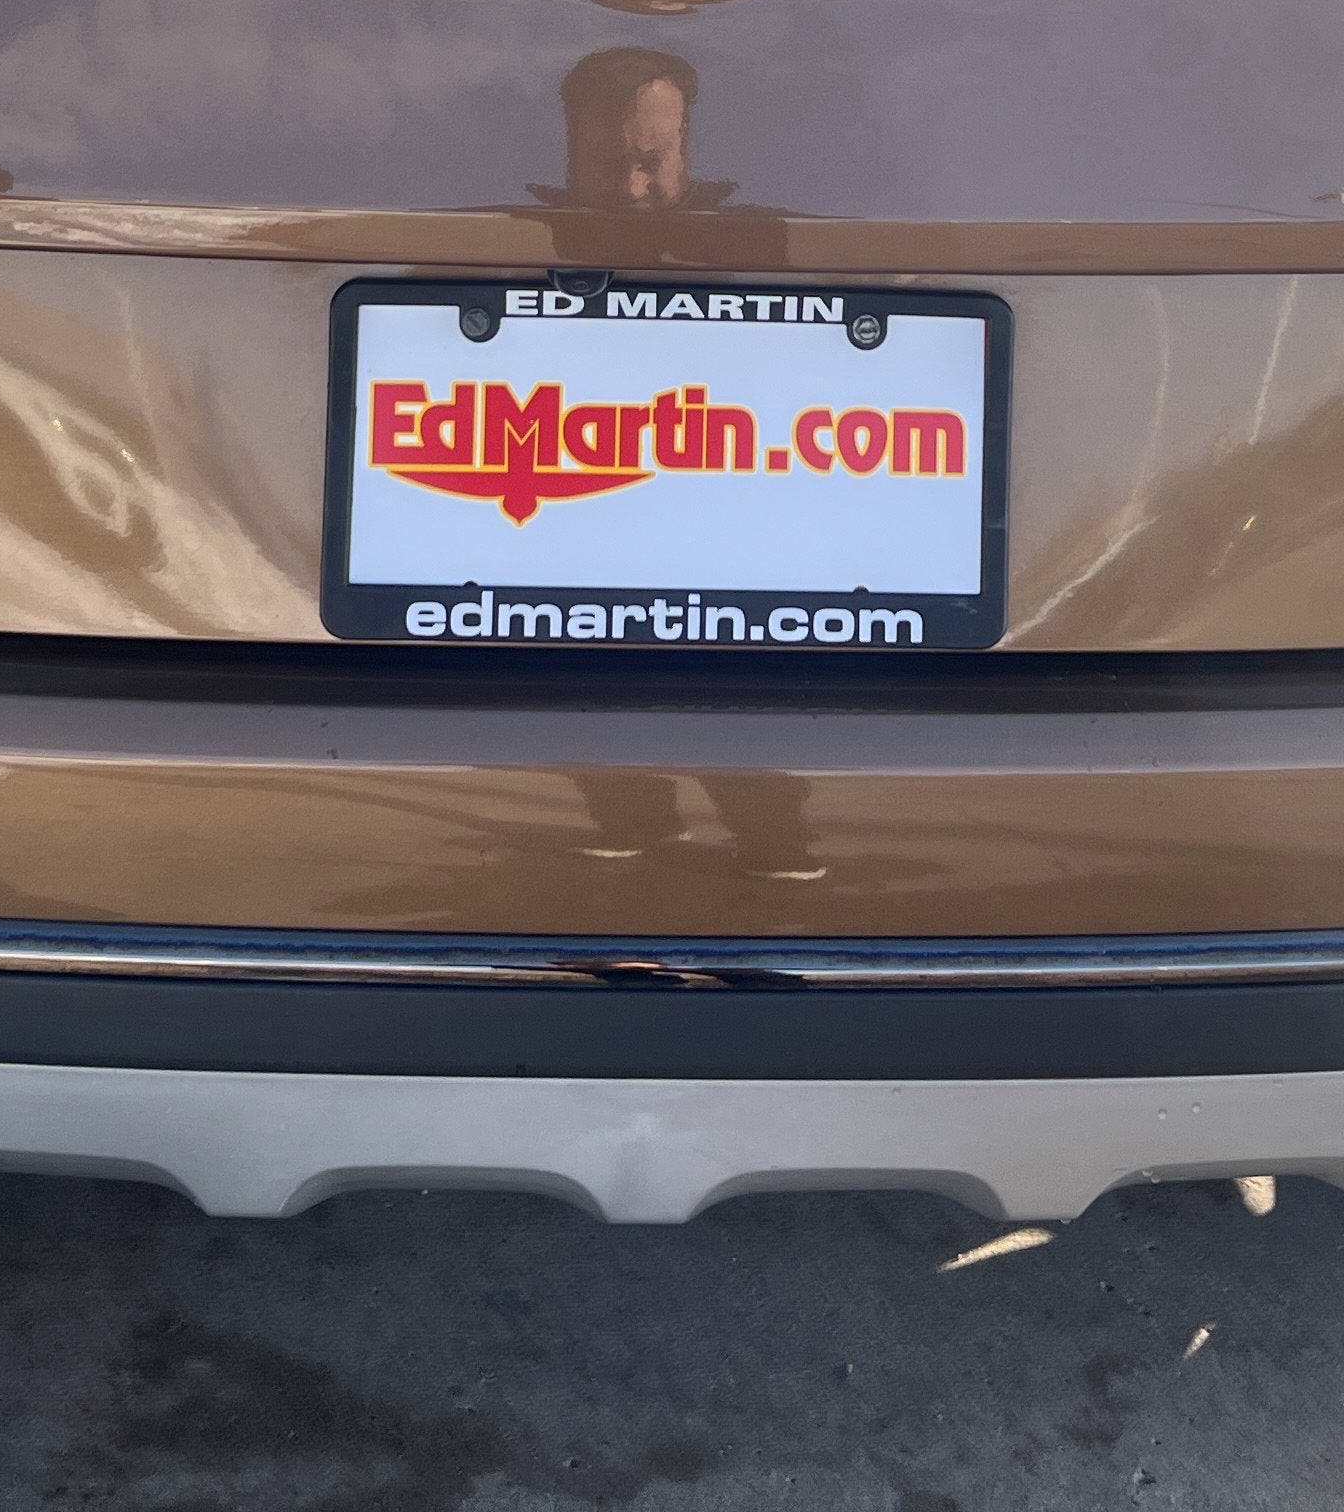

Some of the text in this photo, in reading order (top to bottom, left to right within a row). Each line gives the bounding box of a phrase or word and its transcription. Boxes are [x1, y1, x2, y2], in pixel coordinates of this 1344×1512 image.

[504, 289, 845, 323] ED MARTIN
[404, 590, 925, 645] edmartin.com
